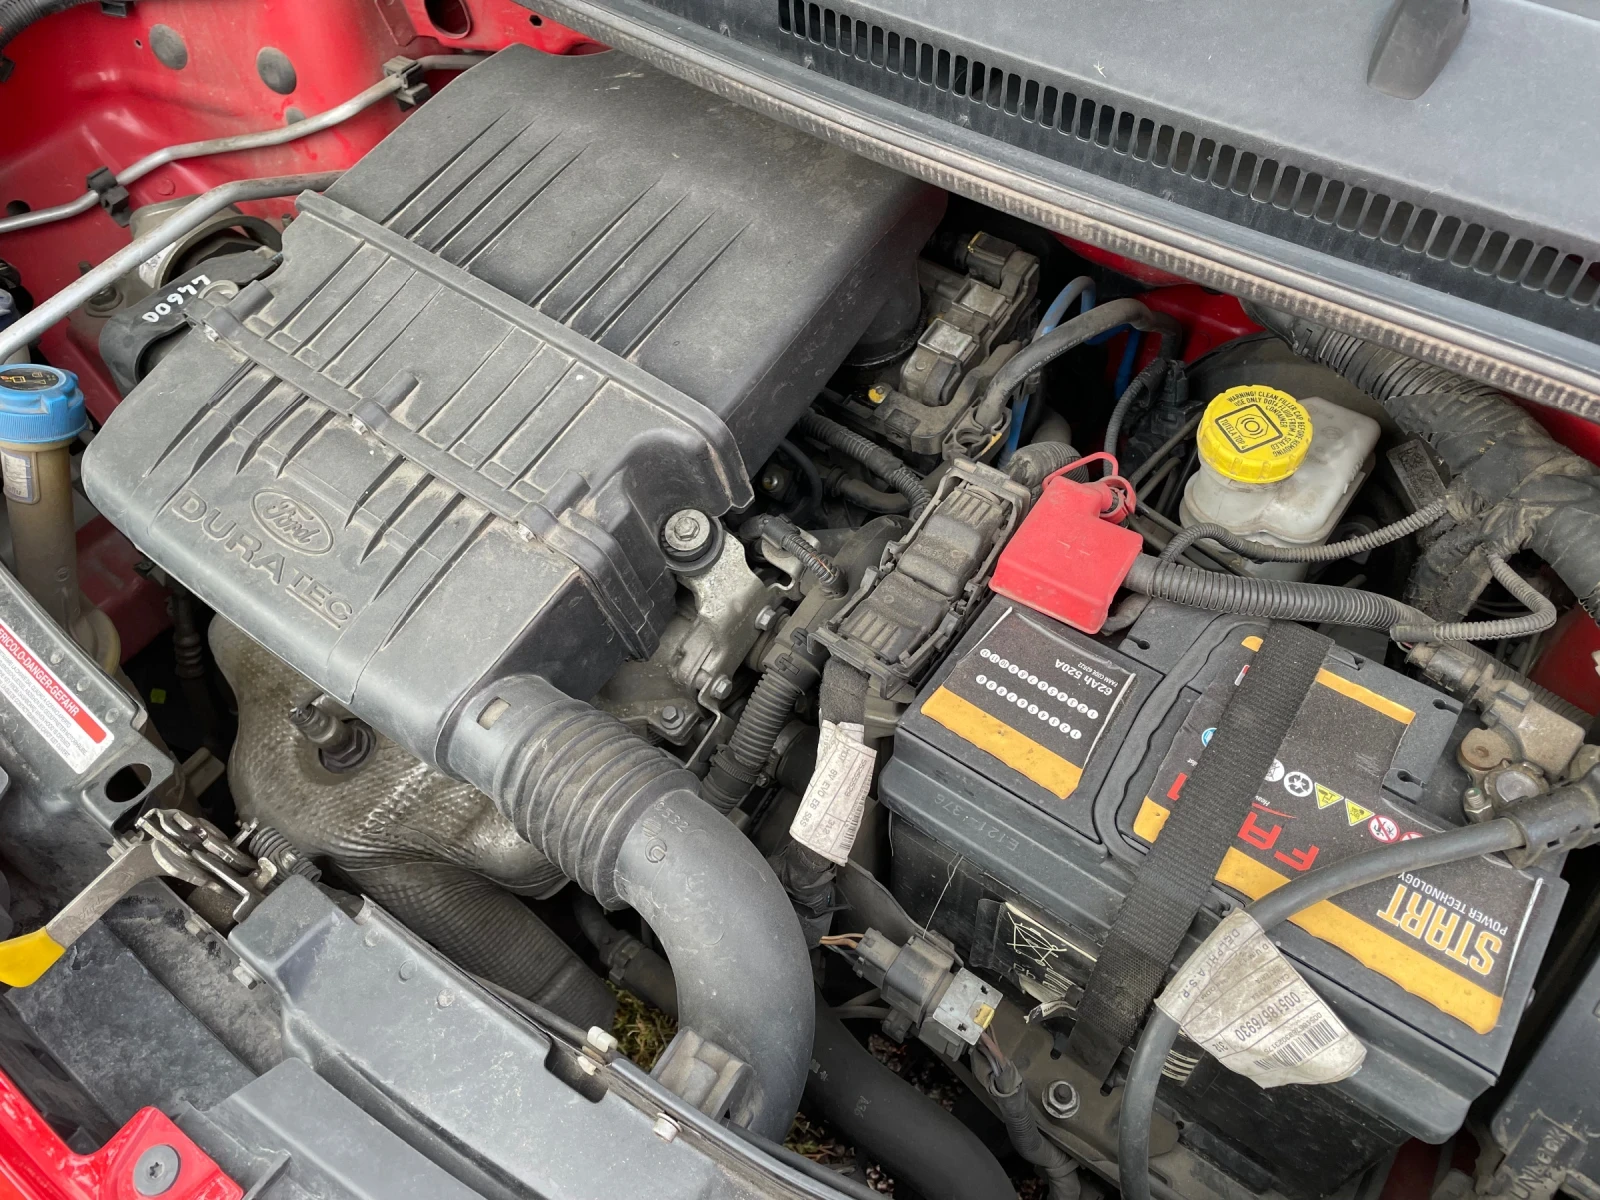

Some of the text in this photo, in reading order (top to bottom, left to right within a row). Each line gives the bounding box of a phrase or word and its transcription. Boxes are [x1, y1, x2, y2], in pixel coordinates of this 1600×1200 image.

[1220, 418, 1236, 436] TUTELA
[1234, 435, 1245, 444] TOP
[1228, 391, 1305, 457] WARNING! CLEAN FILLER CAP BEFORE REMOVING
[1265, 405, 1287, 427] CONTAINER
[1288, 418, 1296, 429] FROM
[260, 495, 320, 549] Ford
[170, 487, 356, 624] DURATEC
[1053, 657, 1113, 697] 62Ah 520A
[815, 780, 830, 798] EVO
[1397, 867, 1509, 936] POWER TECHNOLOGY
[1205, 926, 1240, 968] DELPHI
[1375, 880, 1506, 977] START
[1233, 988, 1301, 1043] 00518676930
